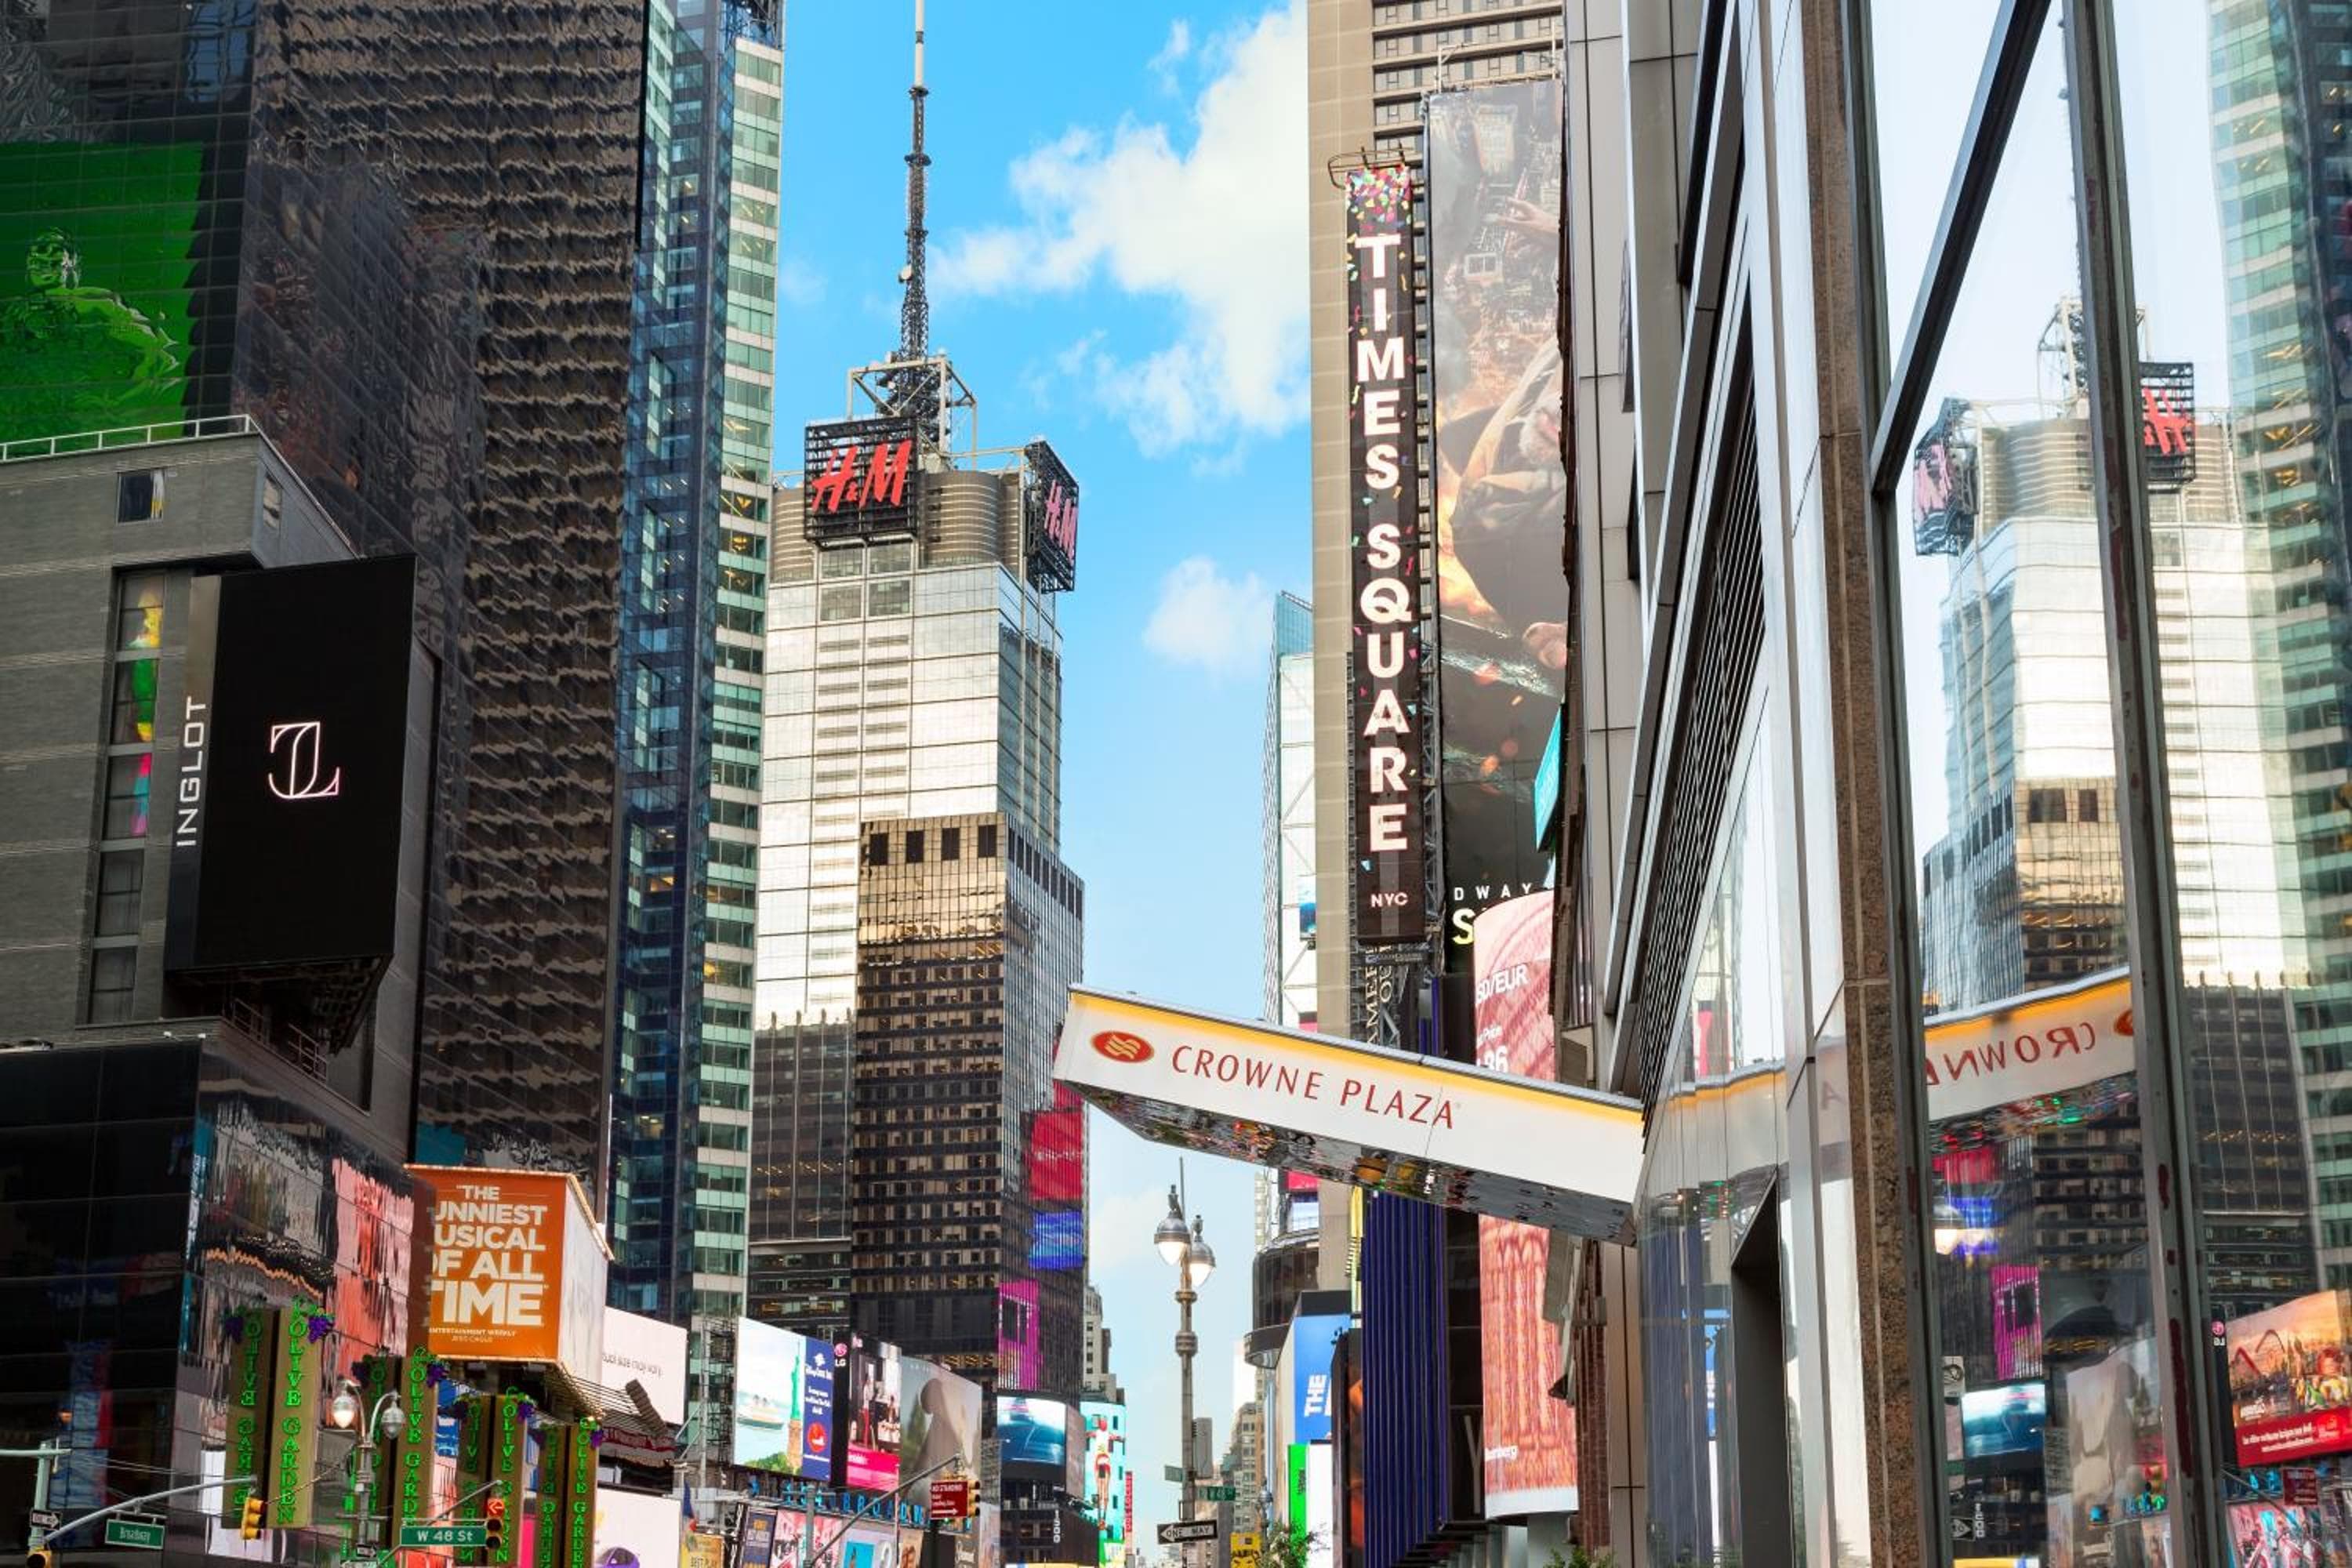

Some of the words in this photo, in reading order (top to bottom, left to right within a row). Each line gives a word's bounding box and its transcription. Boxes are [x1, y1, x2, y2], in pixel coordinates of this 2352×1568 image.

[1355, 234, 1406, 490] TIMES
[811, 438, 913, 515] H&M
[1043, 479, 1079, 566] H&M
[1360, 523, 1412, 852] SQUARE
[177, 696, 206, 847] INGLOT
[1370, 892, 1409, 909] NYC
[1171, 1044, 1324, 1100] CROWNE
[1340, 1079, 1455, 1130] PLAZA
[434, 1224, 546, 1251] USICAL
[436, 1201, 547, 1225] UNNIEST
[470, 1251, 544, 1280] ALL
[287, 1322, 307, 1406] OLIVE
[835, 1359, 847, 1367] LG
[1305, 1374, 1327, 1417] THE
[408, 1367, 426, 1444] OLIVE
[502, 1404, 518, 1472] OLIVE
[278, 1417, 302, 1523] GARDEN
[401, 1454, 422, 1526] GARD
[576, 1436, 590, 1494] OLIVE
[120, 1526, 151, 1543] Broadway
[417, 1530, 429, 1541] W
[457, 1530, 473, 1541] St
[1166, 1528, 1183, 1537] ONE
